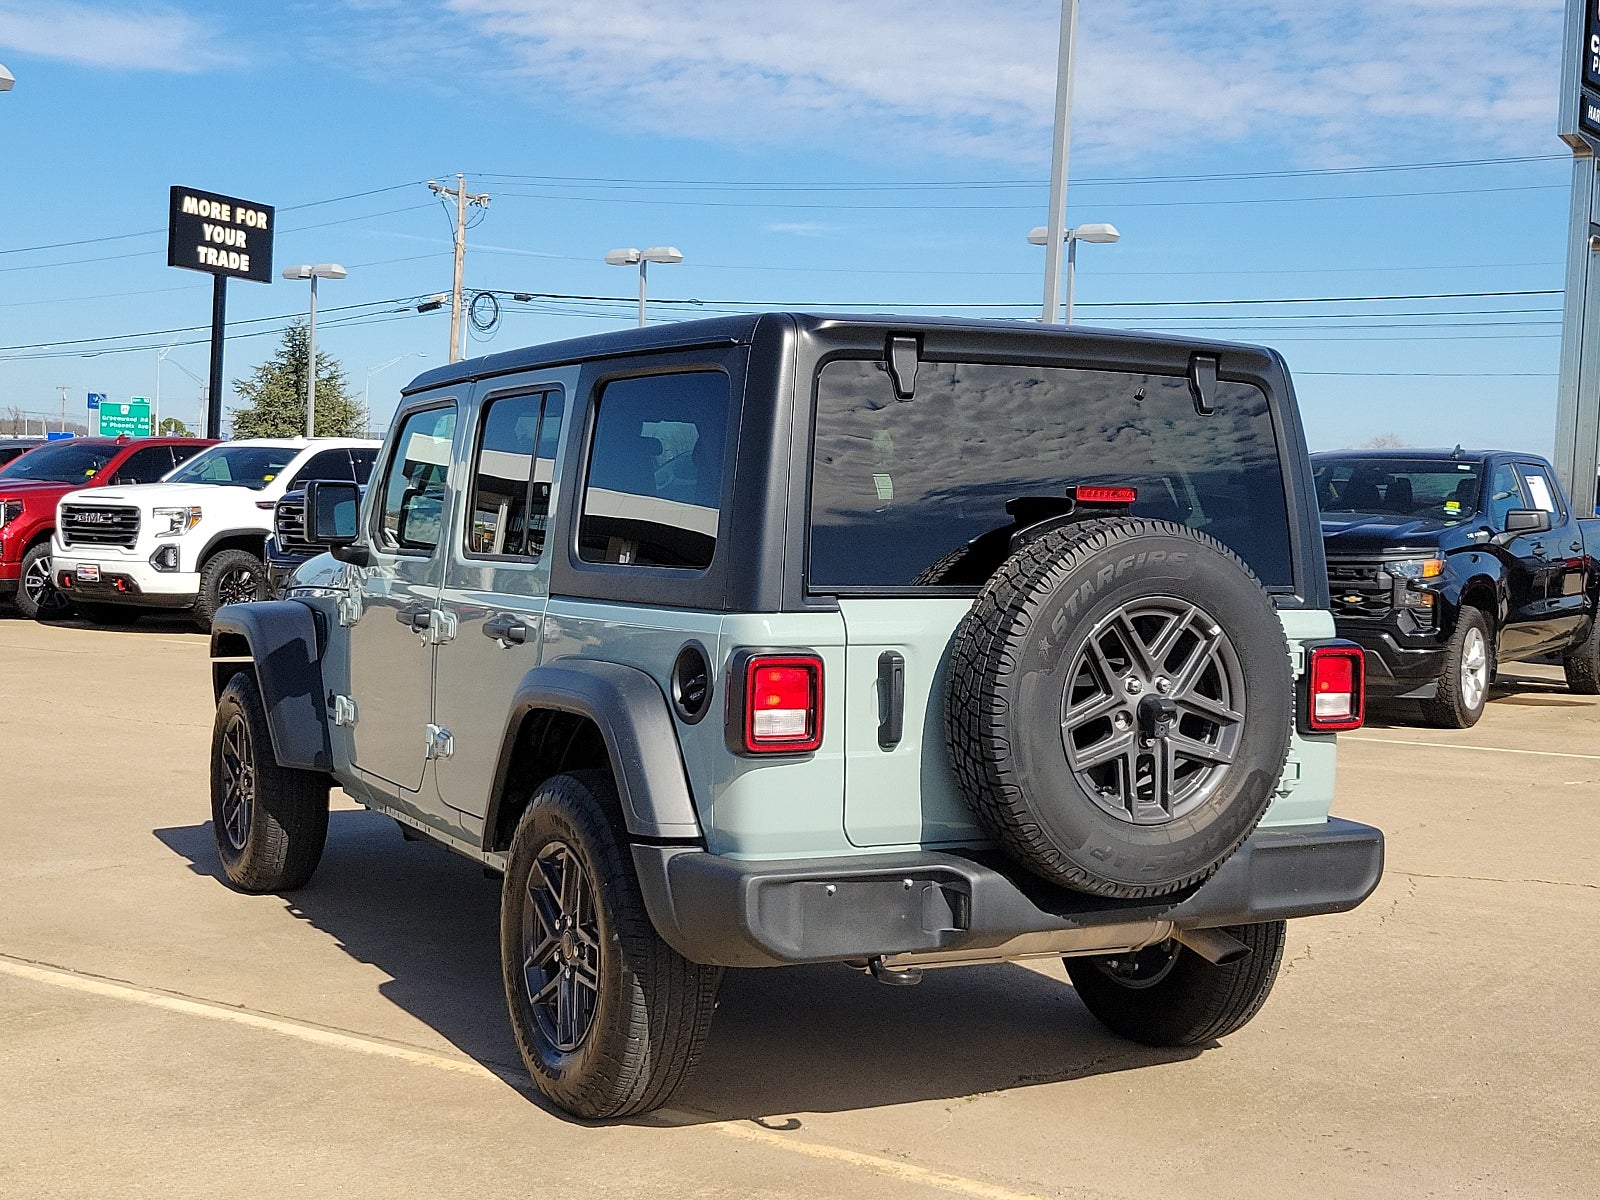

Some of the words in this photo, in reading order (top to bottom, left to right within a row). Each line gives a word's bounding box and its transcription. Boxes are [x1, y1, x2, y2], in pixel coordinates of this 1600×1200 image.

[182, 196, 231, 221] MORE
[235, 207, 267, 229] FOR
[203, 223, 247, 248] YOUR
[197, 245, 249, 271] TRADE
[74, 512, 112, 524] GMC
[1051, 550, 1189, 635] STARFIRE
